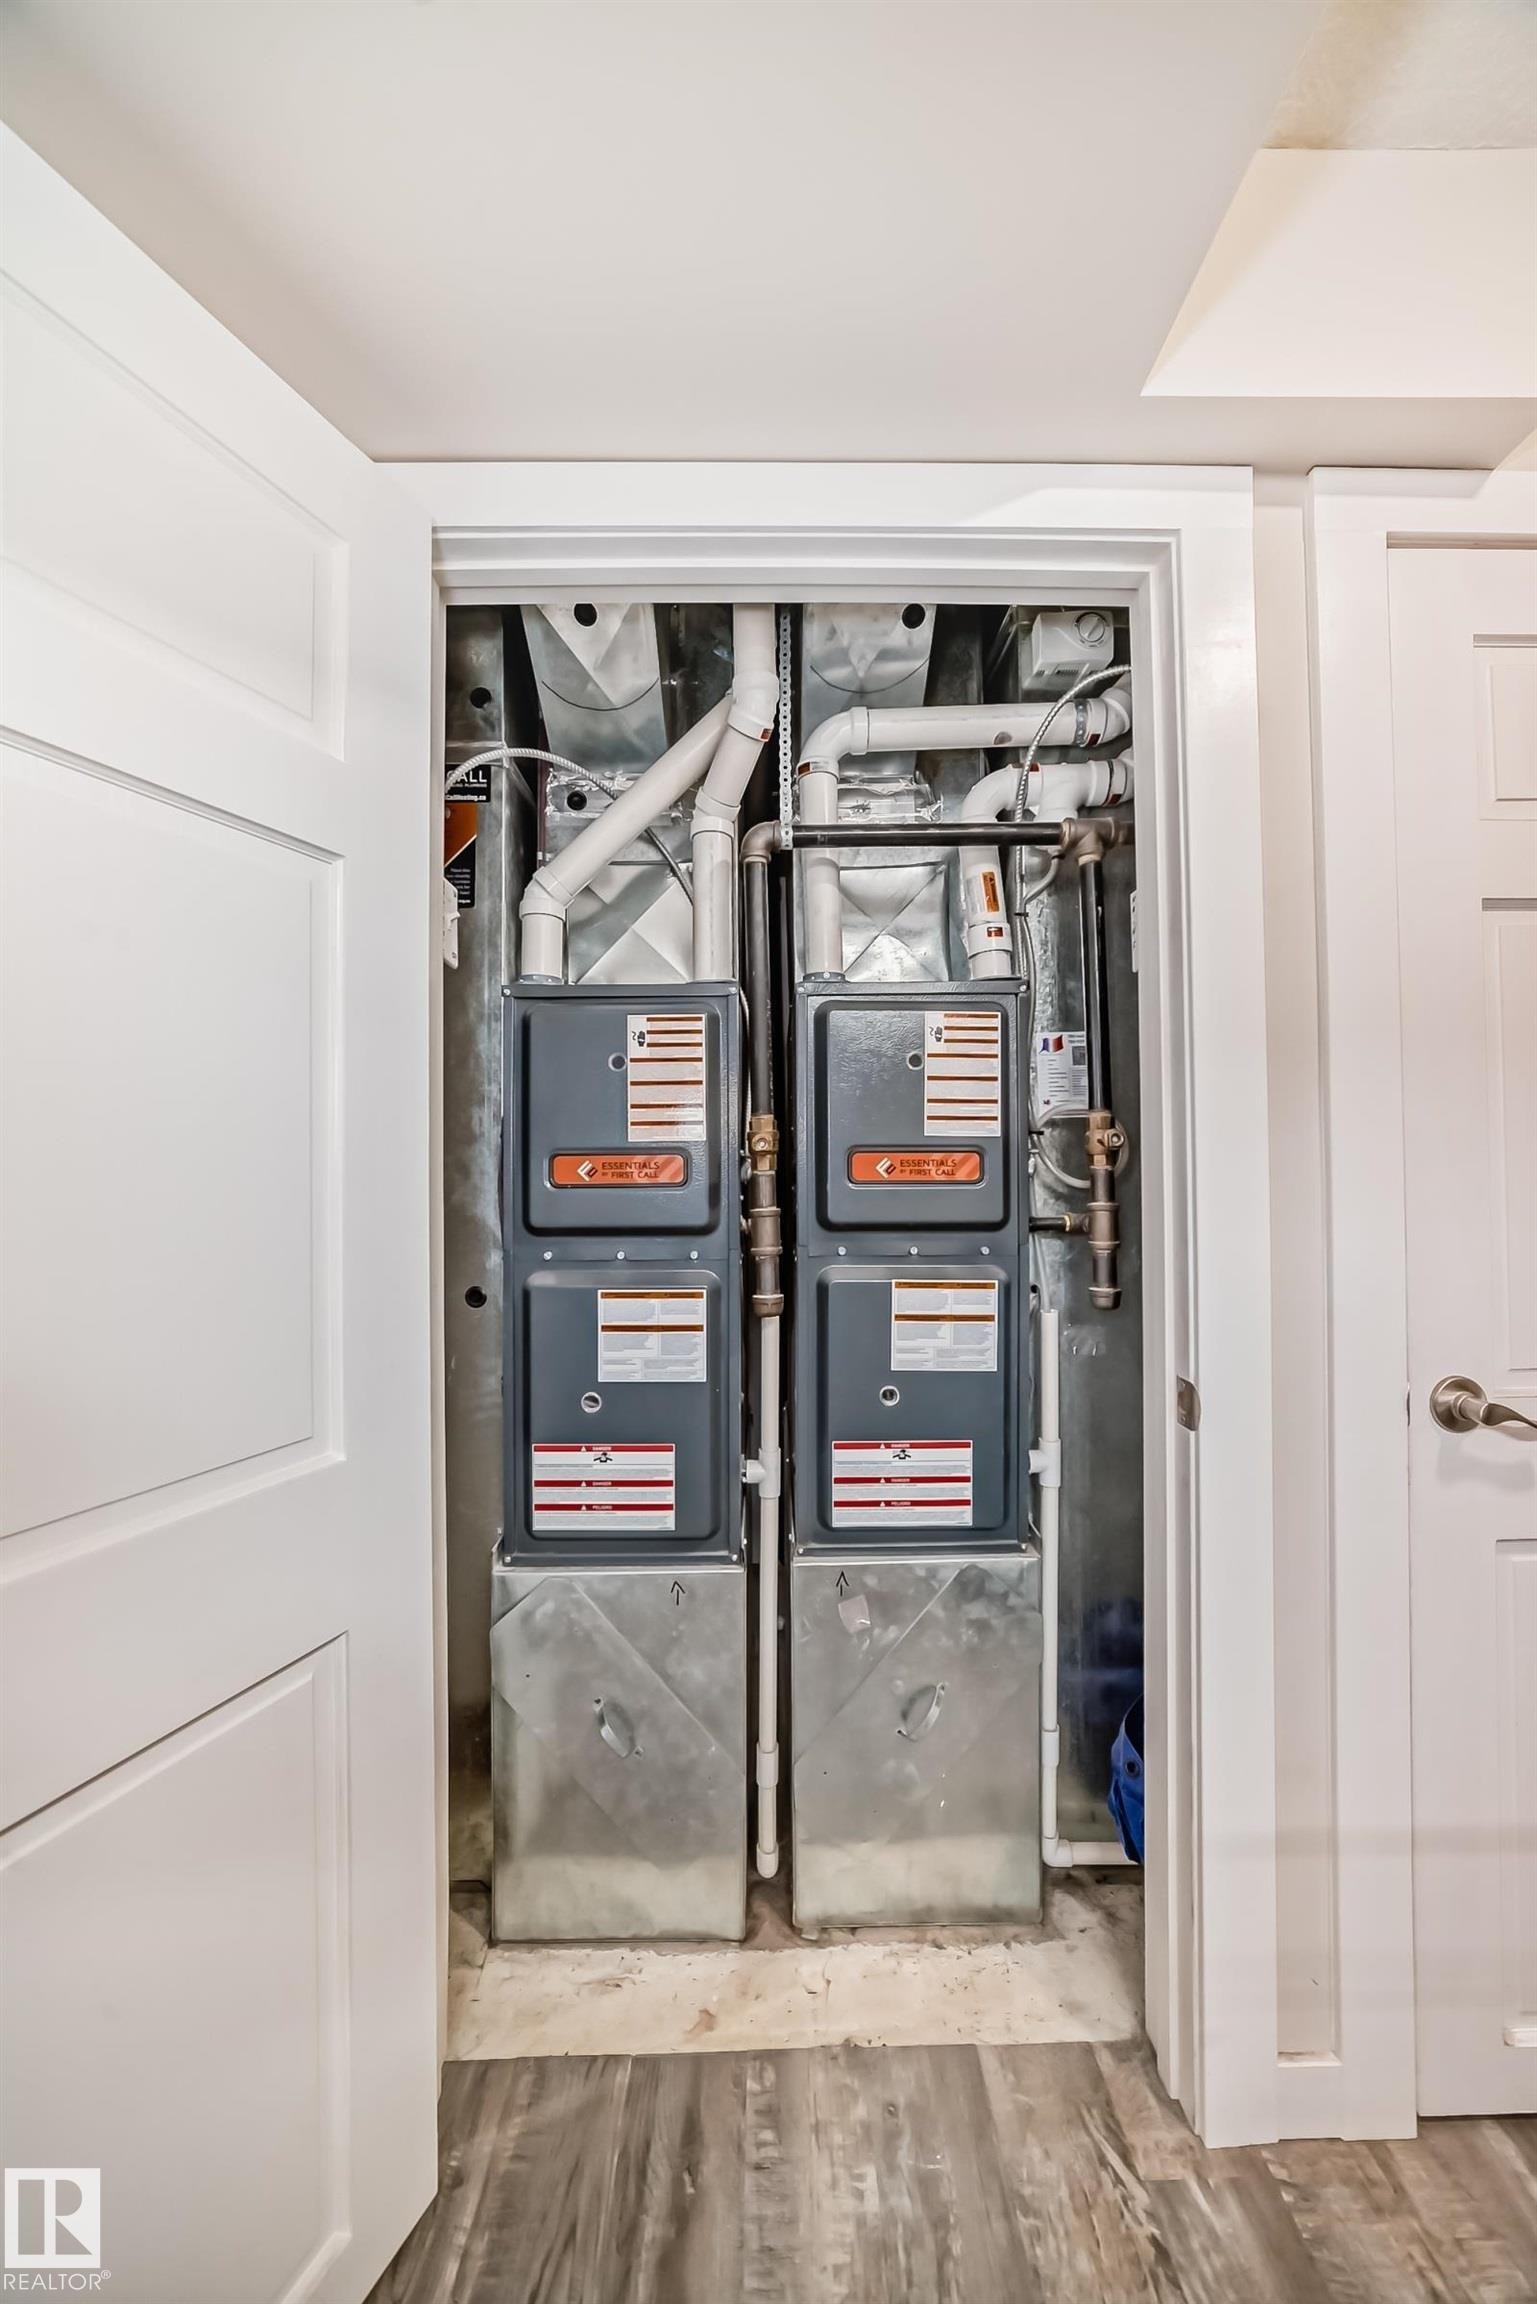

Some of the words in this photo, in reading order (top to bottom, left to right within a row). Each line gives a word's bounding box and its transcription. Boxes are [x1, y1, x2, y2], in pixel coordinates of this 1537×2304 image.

[601, 1161, 660, 1170] ESSENTIALS
[900, 1159, 957, 1168] ESSENTIALS
[610, 1171, 634, 1179] FIRST
[637, 1171, 660, 1179] CALL
[909, 1168, 932, 1177] FIRST
[935, 1168, 956, 1177] CALL
